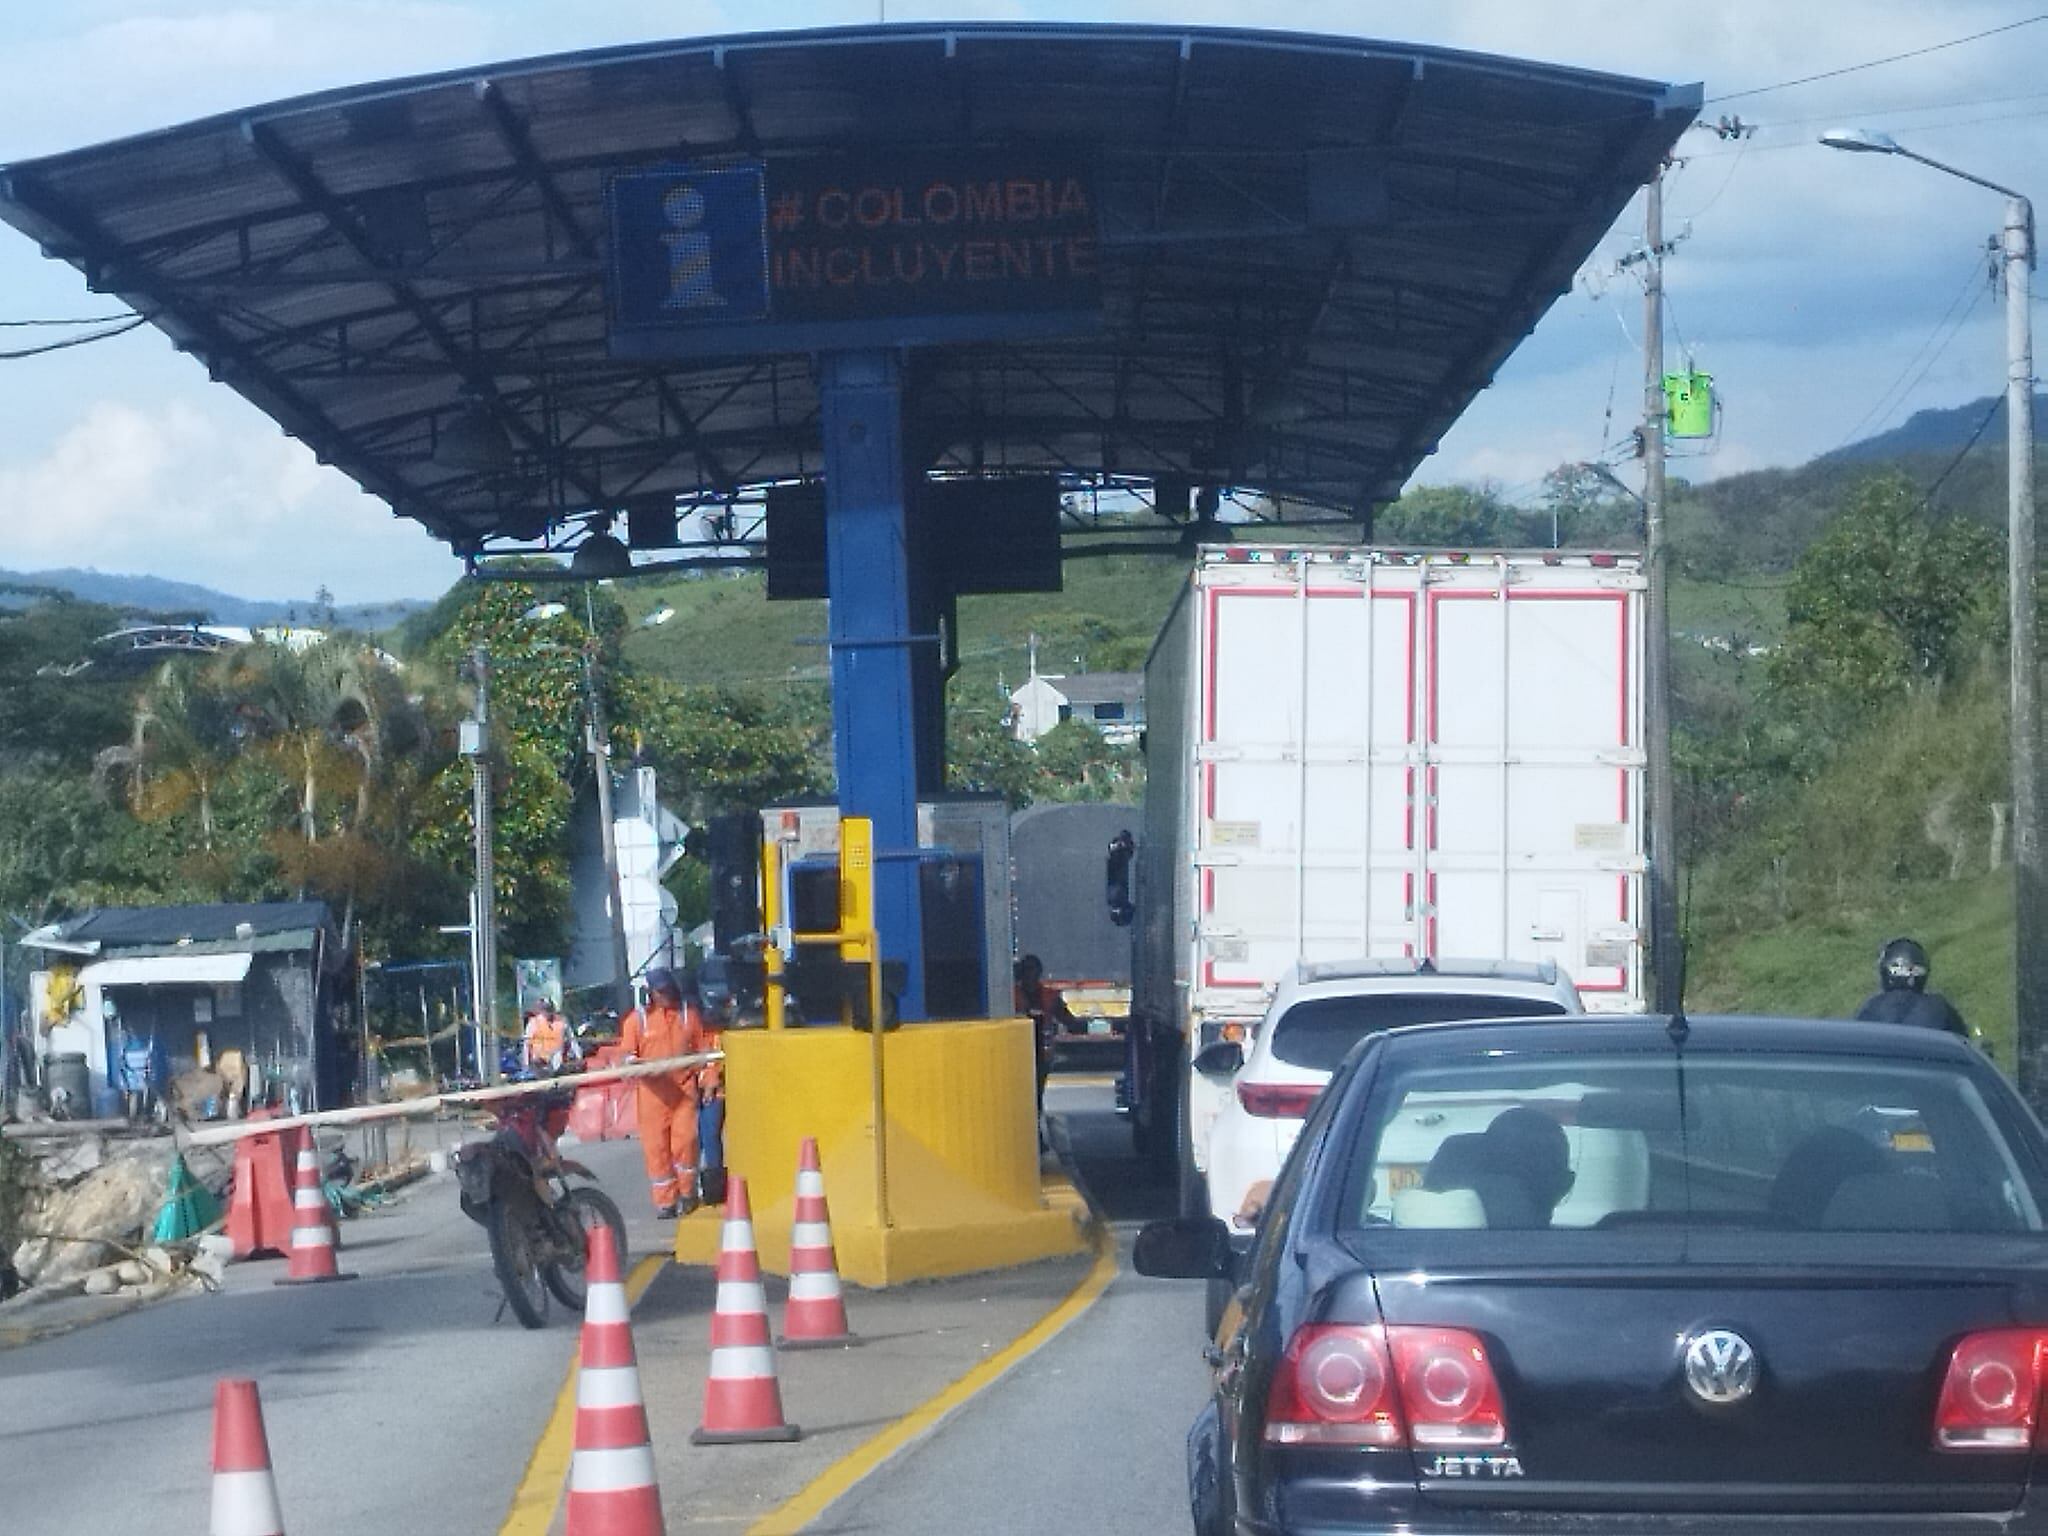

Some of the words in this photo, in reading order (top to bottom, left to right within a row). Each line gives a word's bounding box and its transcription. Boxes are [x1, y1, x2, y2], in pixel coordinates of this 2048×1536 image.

[816, 178, 1089, 228] COLOMBIA
[772, 235, 1096, 287] INCLUYENTE
[1421, 1456, 1524, 1476] JETTA
